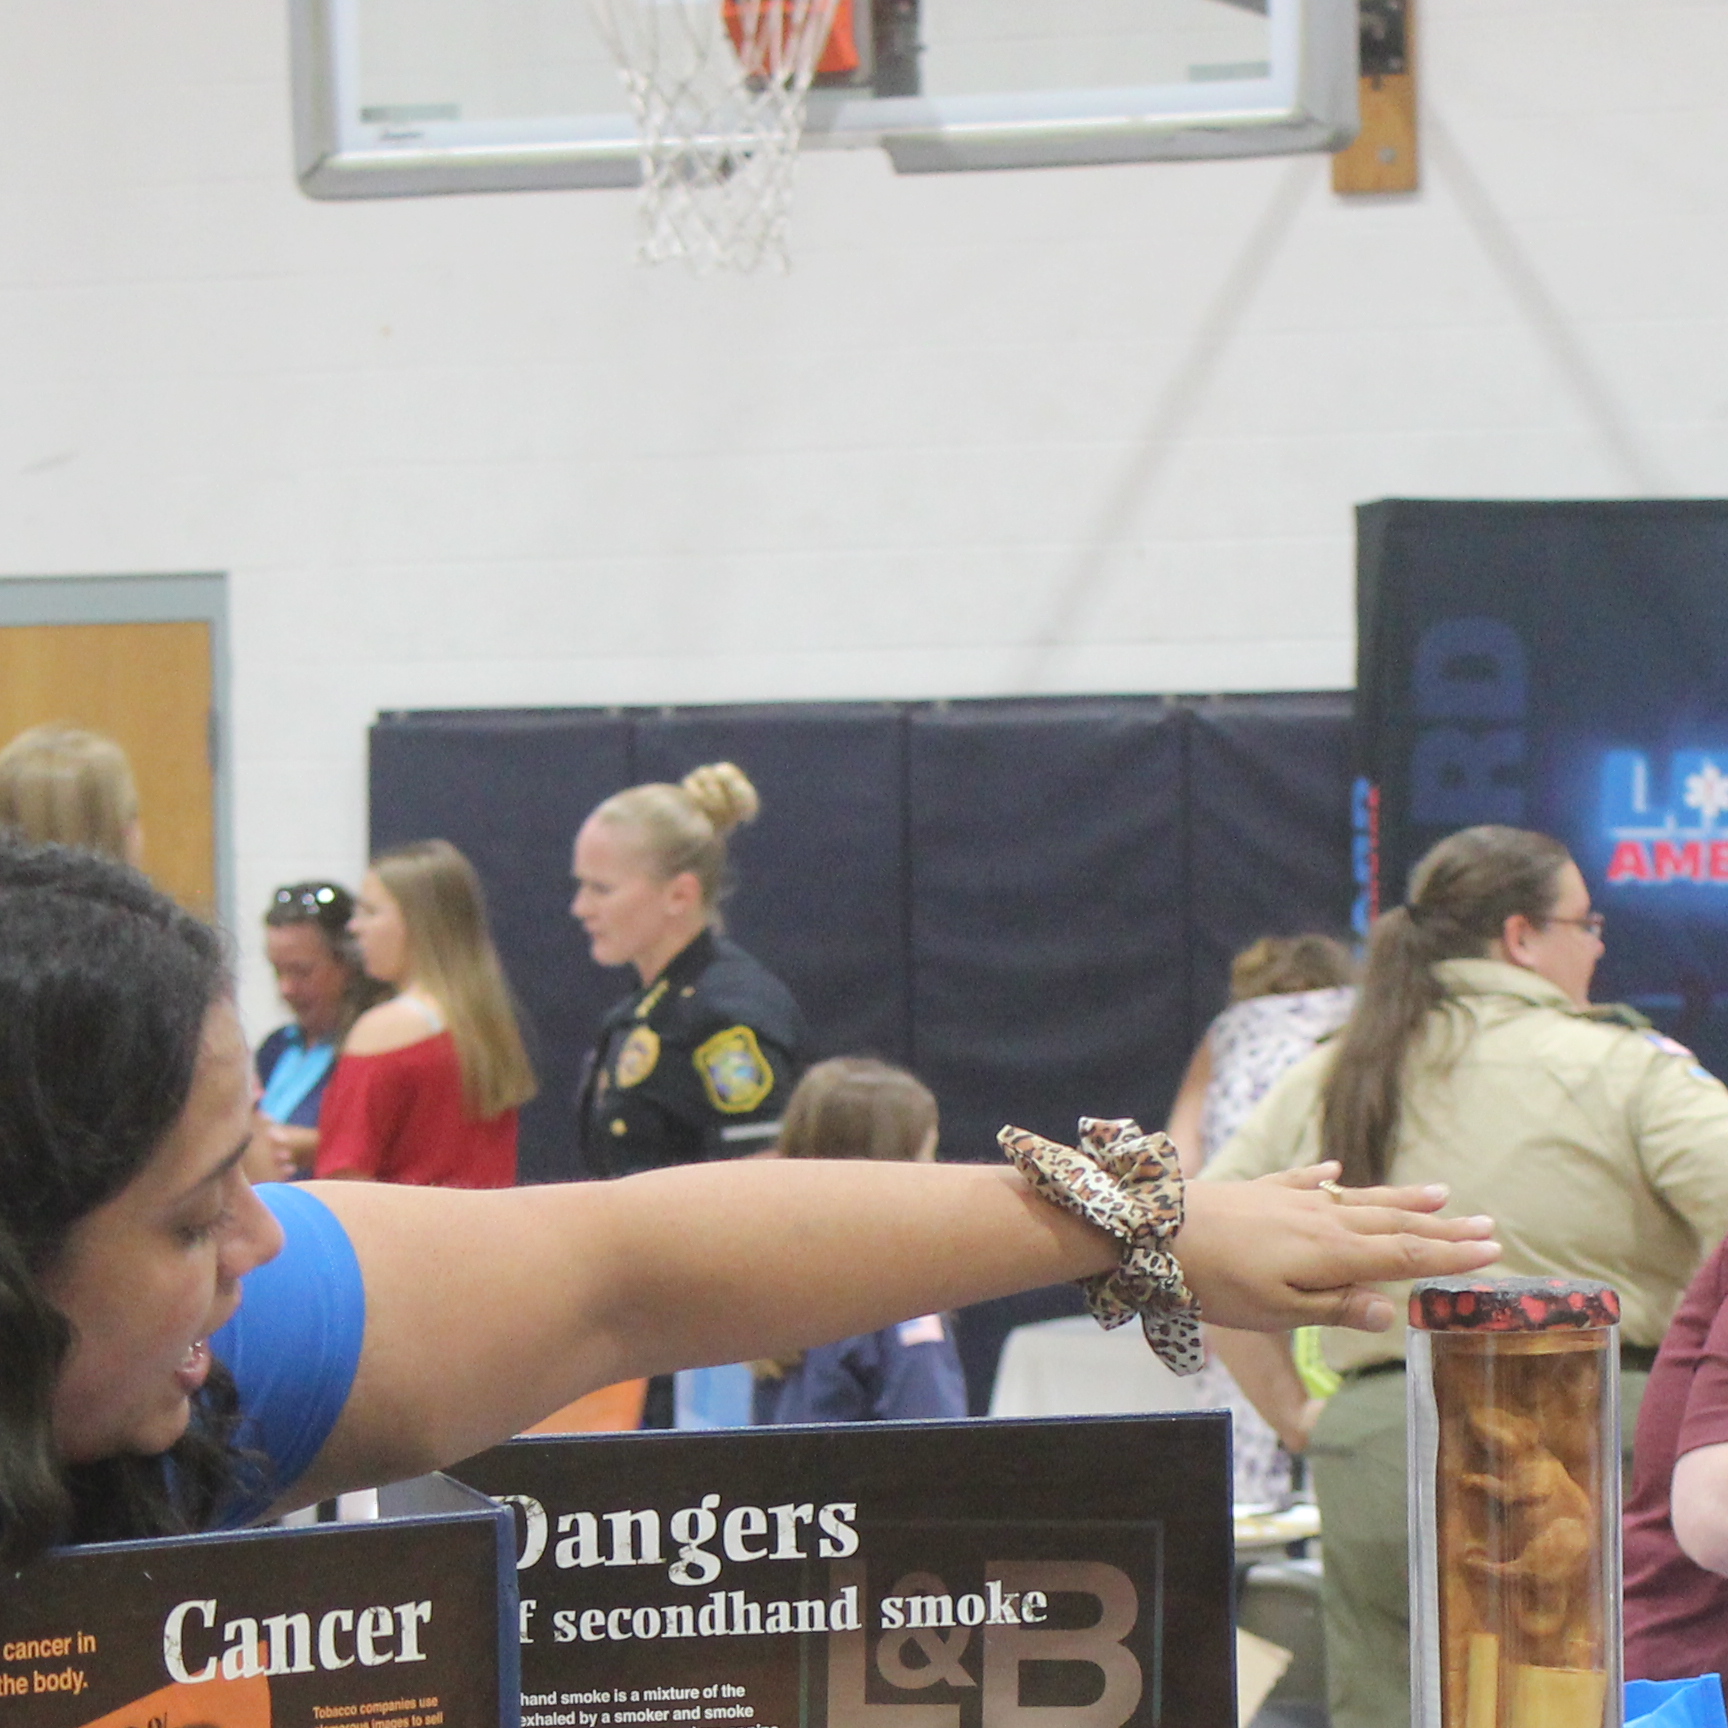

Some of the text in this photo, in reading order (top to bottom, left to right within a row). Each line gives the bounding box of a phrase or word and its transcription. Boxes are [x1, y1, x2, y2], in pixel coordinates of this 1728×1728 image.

[553, 1579, 1048, 1644] secondhand smoke
[3, 1636, 71, 1662] cancer
[77, 1630, 97, 1654] in
[163, 1598, 433, 1684] Cancer
[33, 1667, 89, 1694] body.
